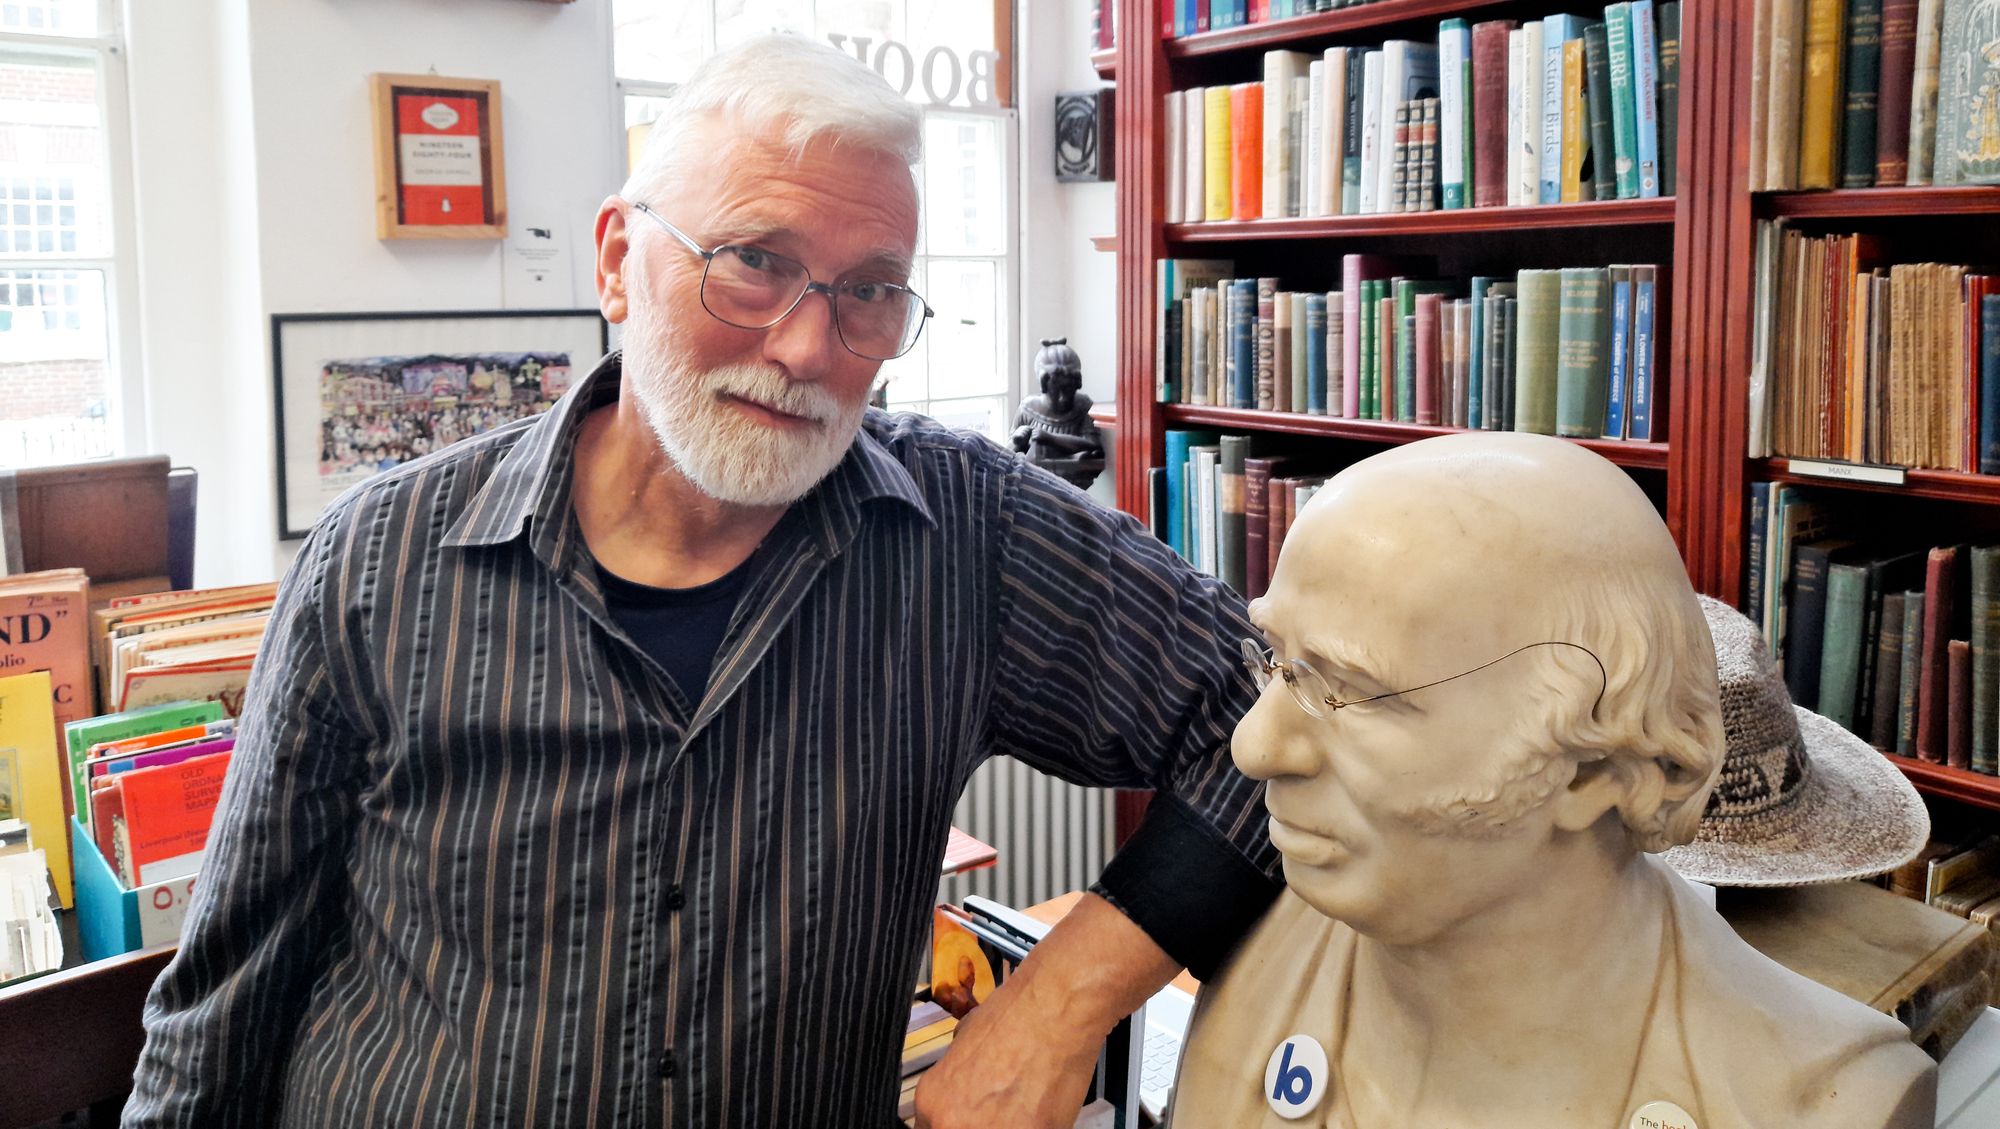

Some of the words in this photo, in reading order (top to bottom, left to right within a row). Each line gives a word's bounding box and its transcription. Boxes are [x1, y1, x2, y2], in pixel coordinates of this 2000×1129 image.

[1609, 16, 1627, 88] HILBRE
[1546, 46, 1560, 106] Extinct
[1545, 113, 1559, 154] Birds
[1613, 332, 1622, 367] FLOWERS
[1638, 333, 1647, 367] FLOWERS
[1613, 367, 1621, 376] of
[1638, 367, 1646, 376] of
[1611, 376, 1620, 403] GREECE
[1637, 376, 1645, 405] GREECE
[1828, 466, 1853, 476] MANX
[180, 767, 204, 781] OLD
[1272, 1041, 1313, 1106] b
[1640, 1116, 1659, 1129] The
